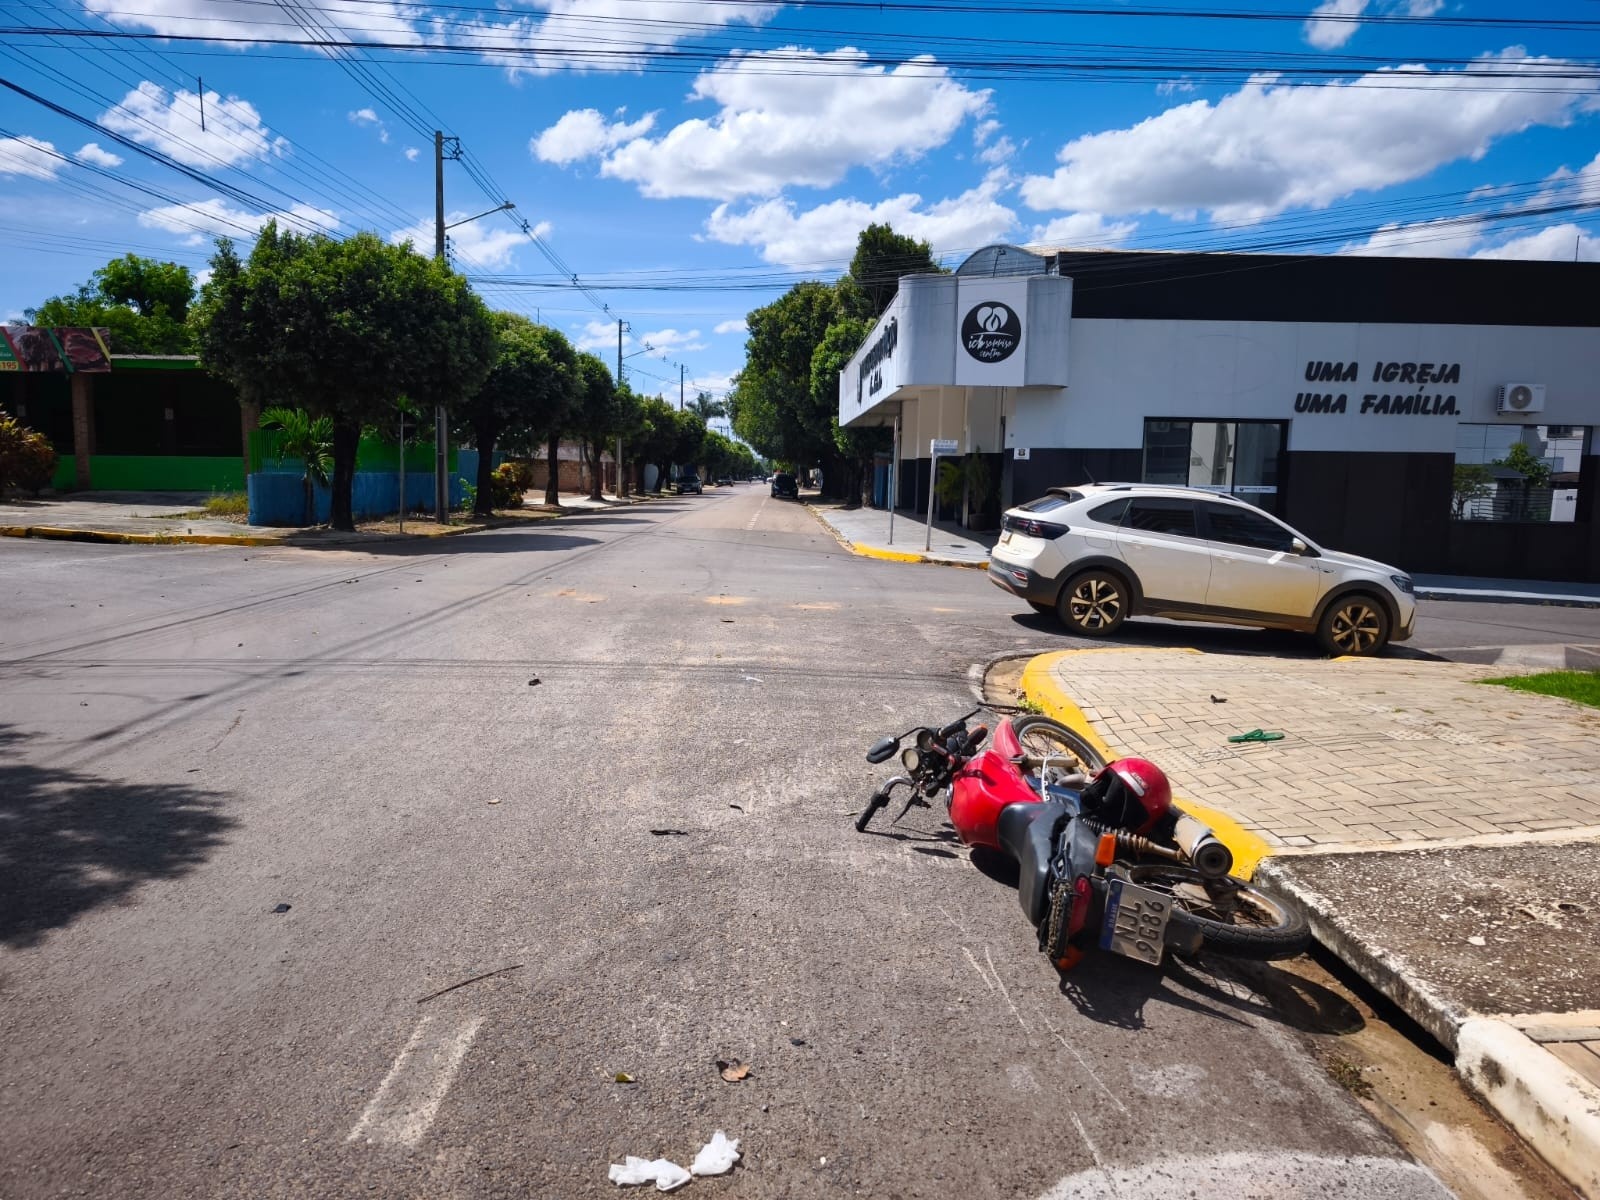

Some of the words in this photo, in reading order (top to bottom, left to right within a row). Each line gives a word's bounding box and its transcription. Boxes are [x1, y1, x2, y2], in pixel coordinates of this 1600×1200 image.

[1304, 361, 1359, 382] UMA
[1372, 361, 1461, 384] IGREJA
[1294, 393, 1347, 414] UMA
[1359, 386, 1461, 416] FAMÍLIA.
[1114, 902, 1142, 942] NJL
[1136, 899, 1165, 955] 9G86
